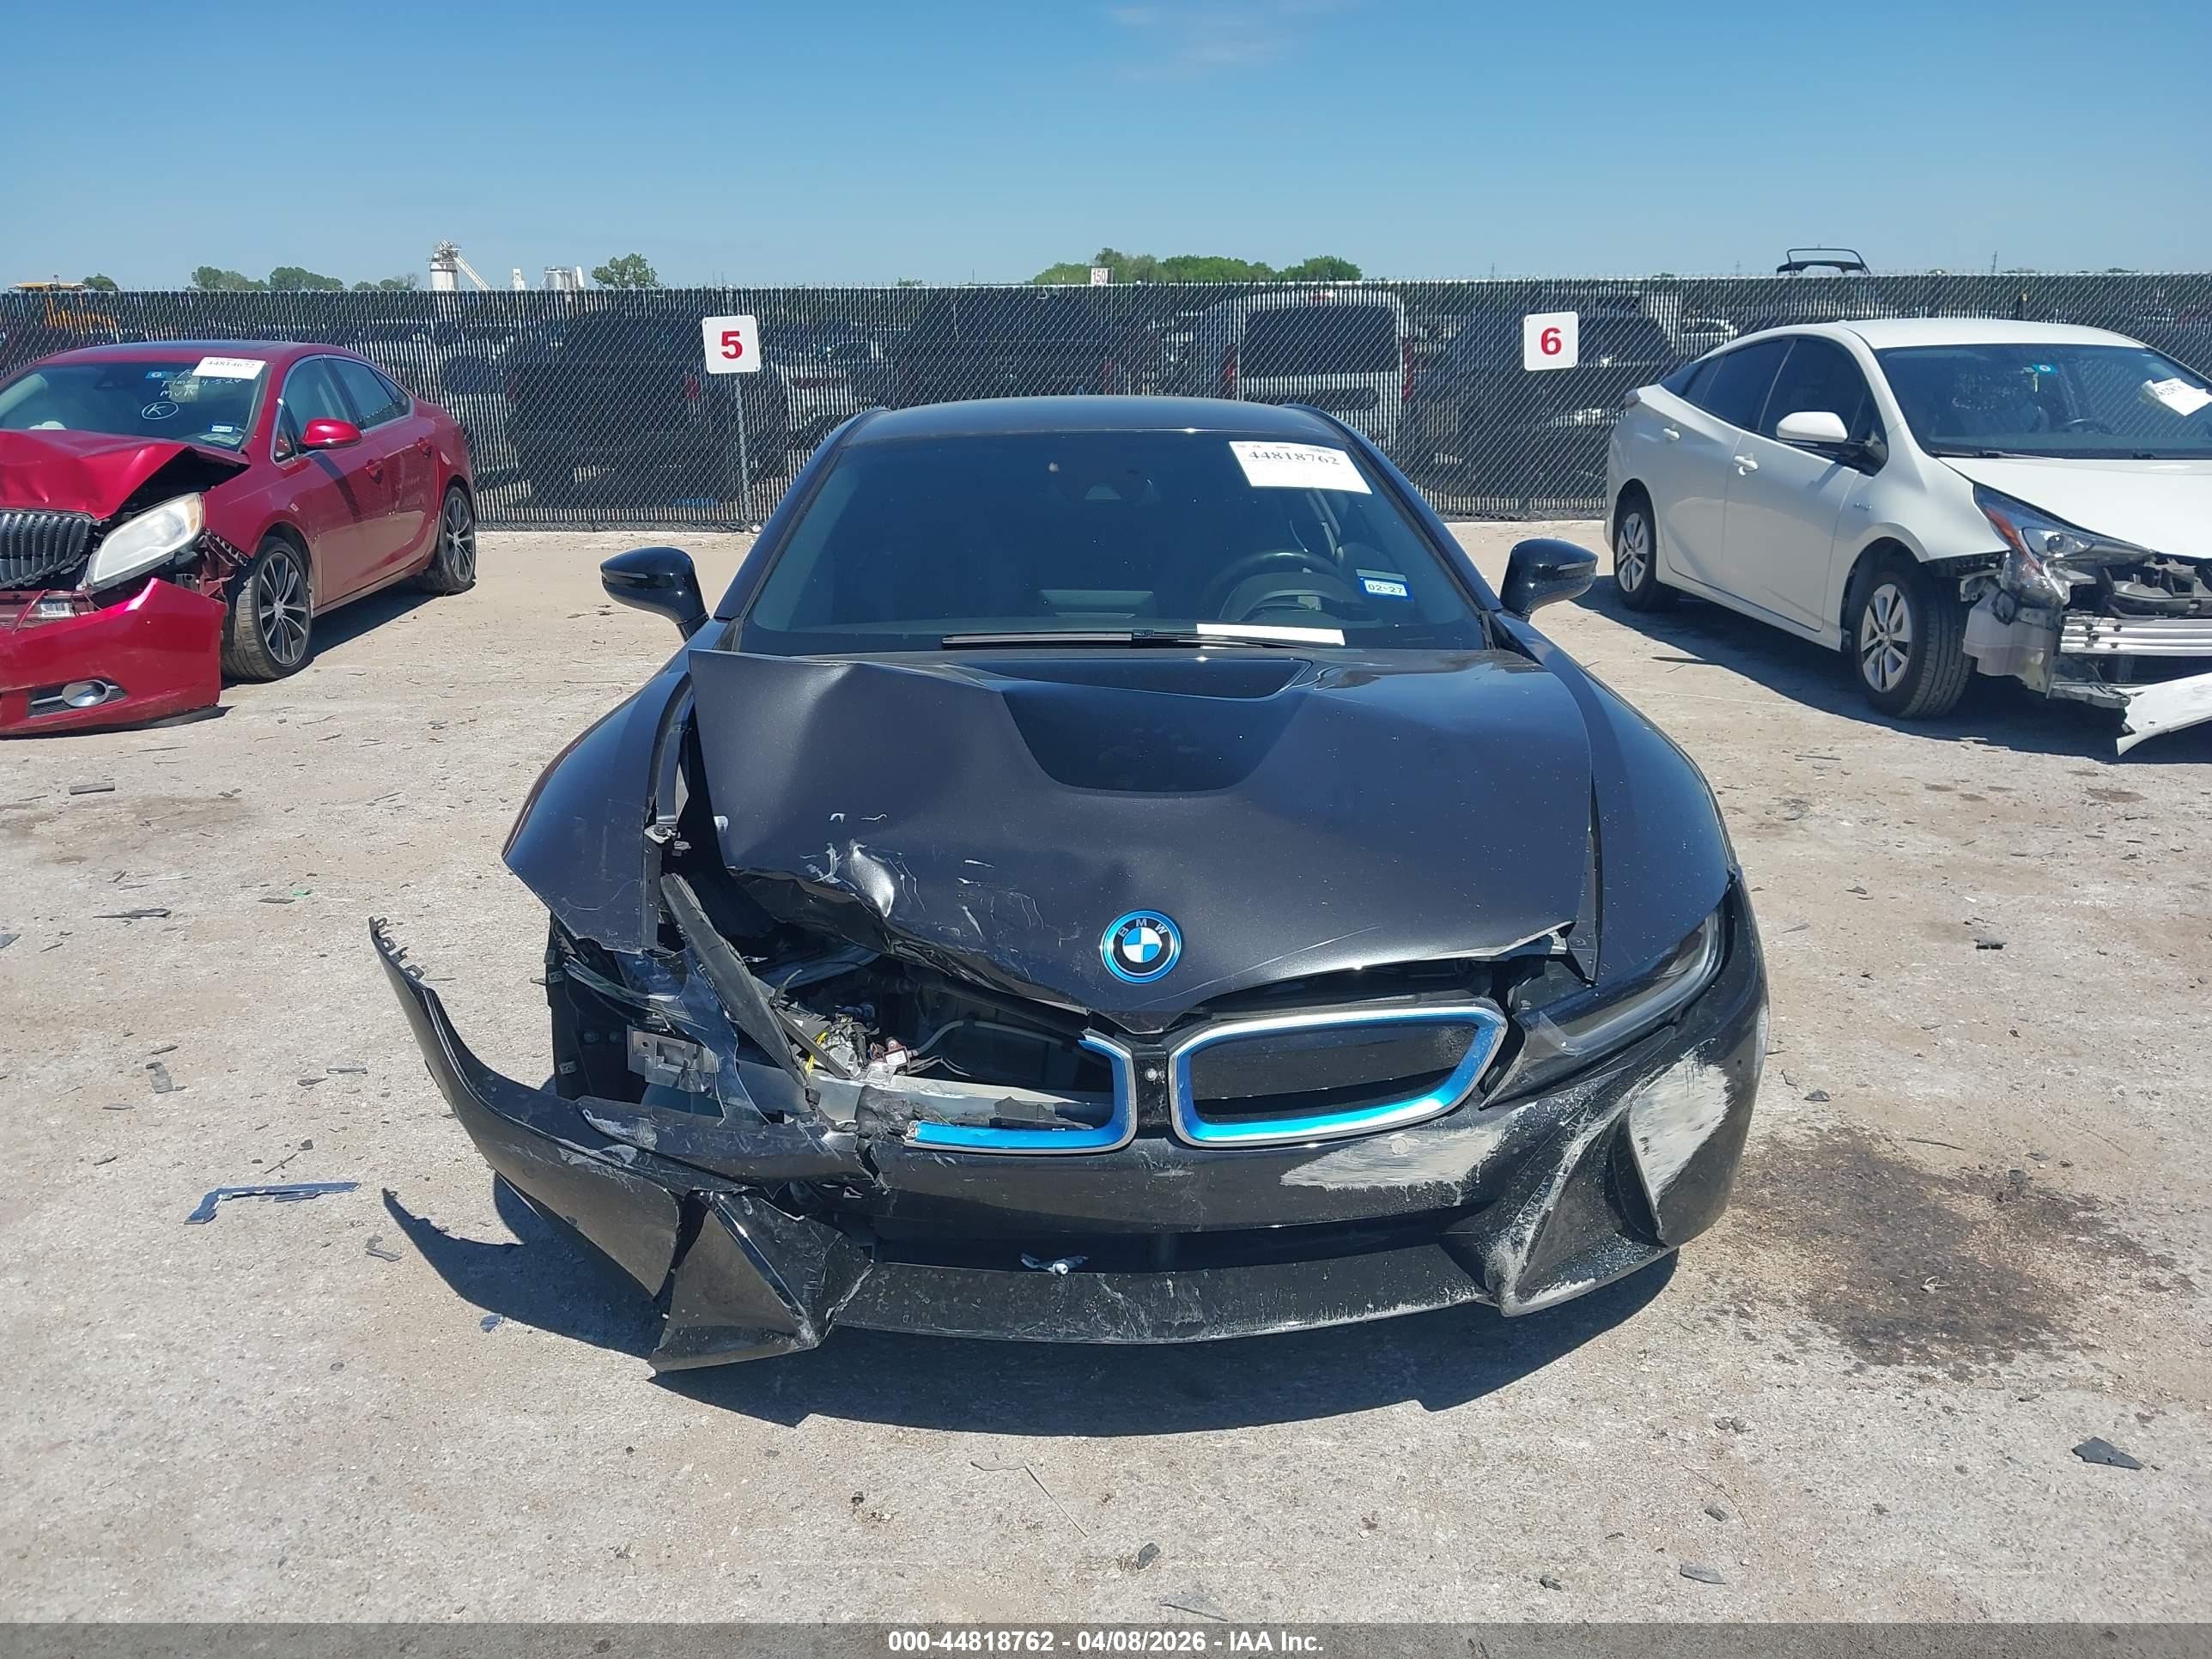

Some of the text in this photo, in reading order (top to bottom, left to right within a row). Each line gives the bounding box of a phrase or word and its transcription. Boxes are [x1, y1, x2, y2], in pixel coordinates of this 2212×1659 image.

[1093, 270, 1106, 283] 150
[720, 330, 743, 360] 5
[1540, 326, 1562, 356] 6
[1249, 451, 1340, 465] 44818762
[1118, 918, 1169, 938] BMW
